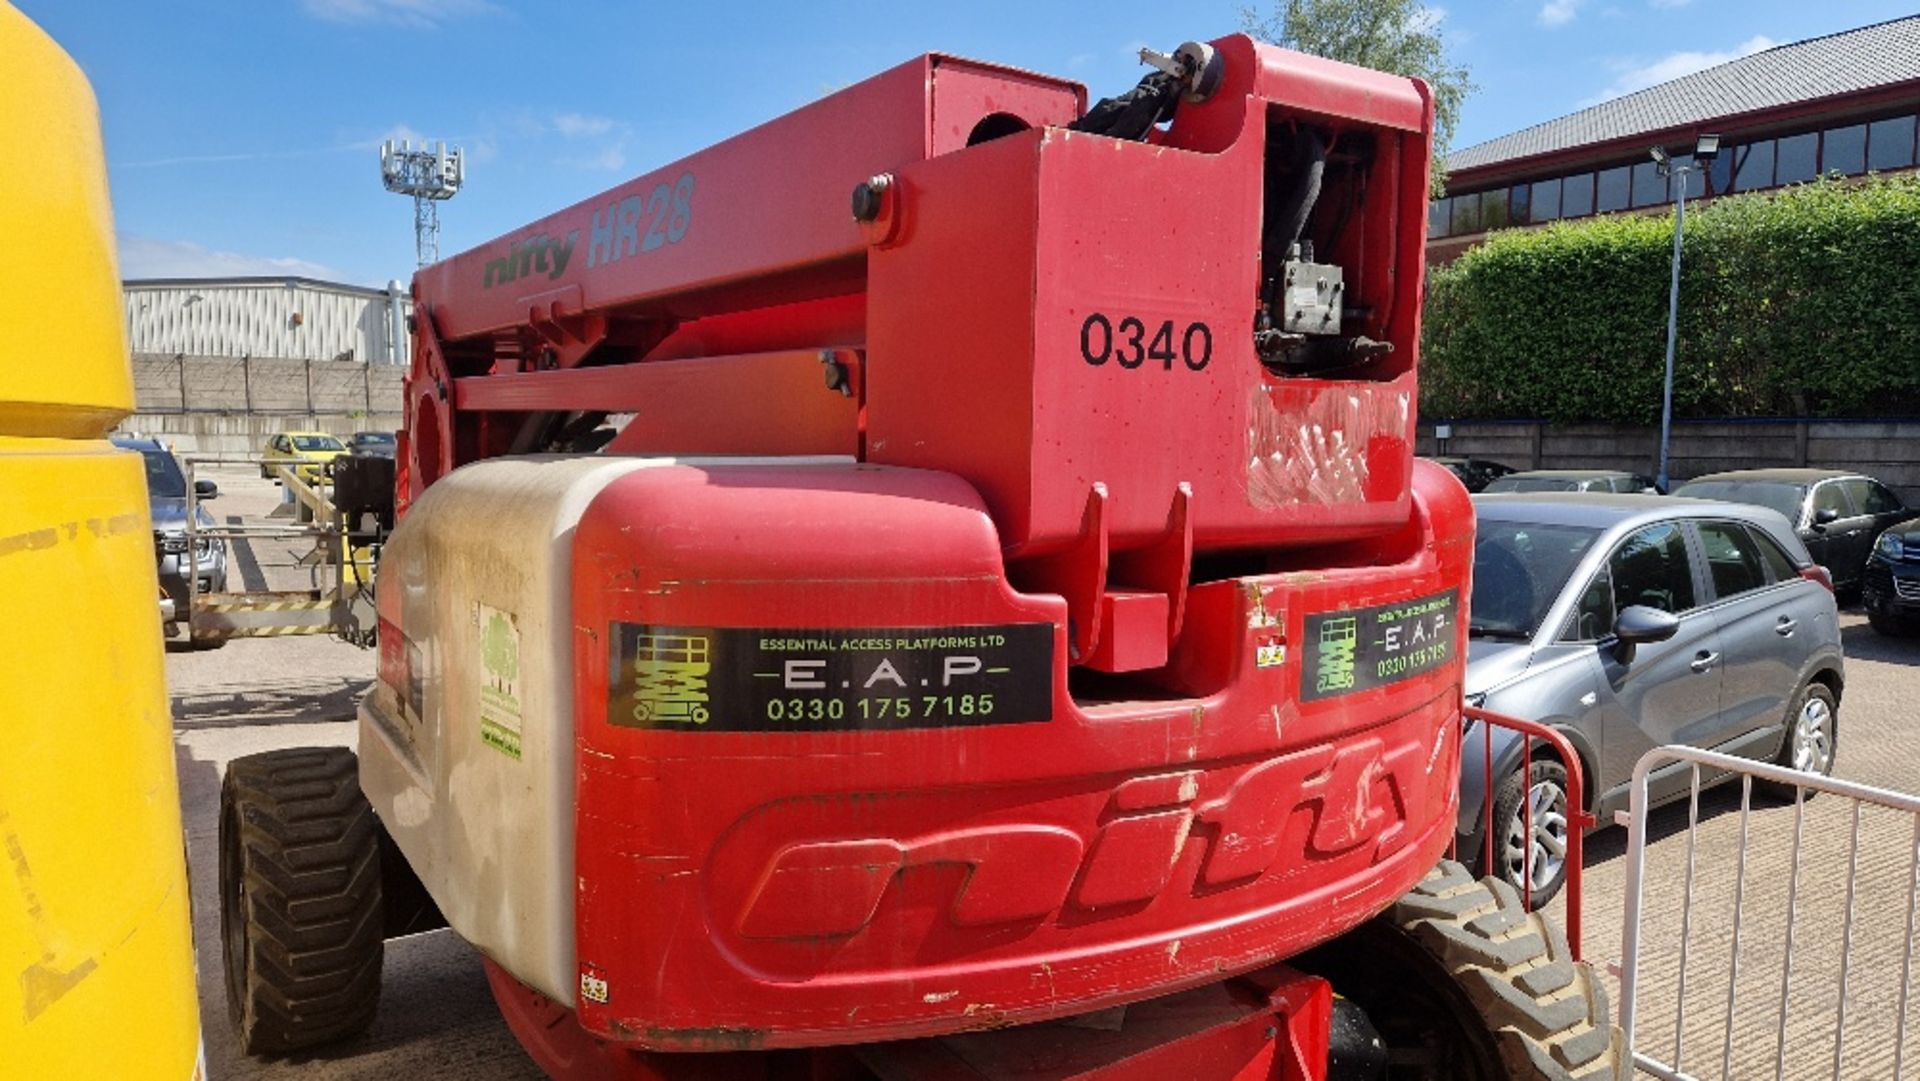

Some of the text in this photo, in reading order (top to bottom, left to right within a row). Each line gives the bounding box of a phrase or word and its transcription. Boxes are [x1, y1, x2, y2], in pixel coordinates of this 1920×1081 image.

[483, 172, 694, 288] nifty HR28
[1080, 312, 1212, 372] 0340
[759, 634, 1006, 651] ESSENTIAL ACCESS PLATFORMS LTD
[767, 694, 995, 720] 0330 175 7185
